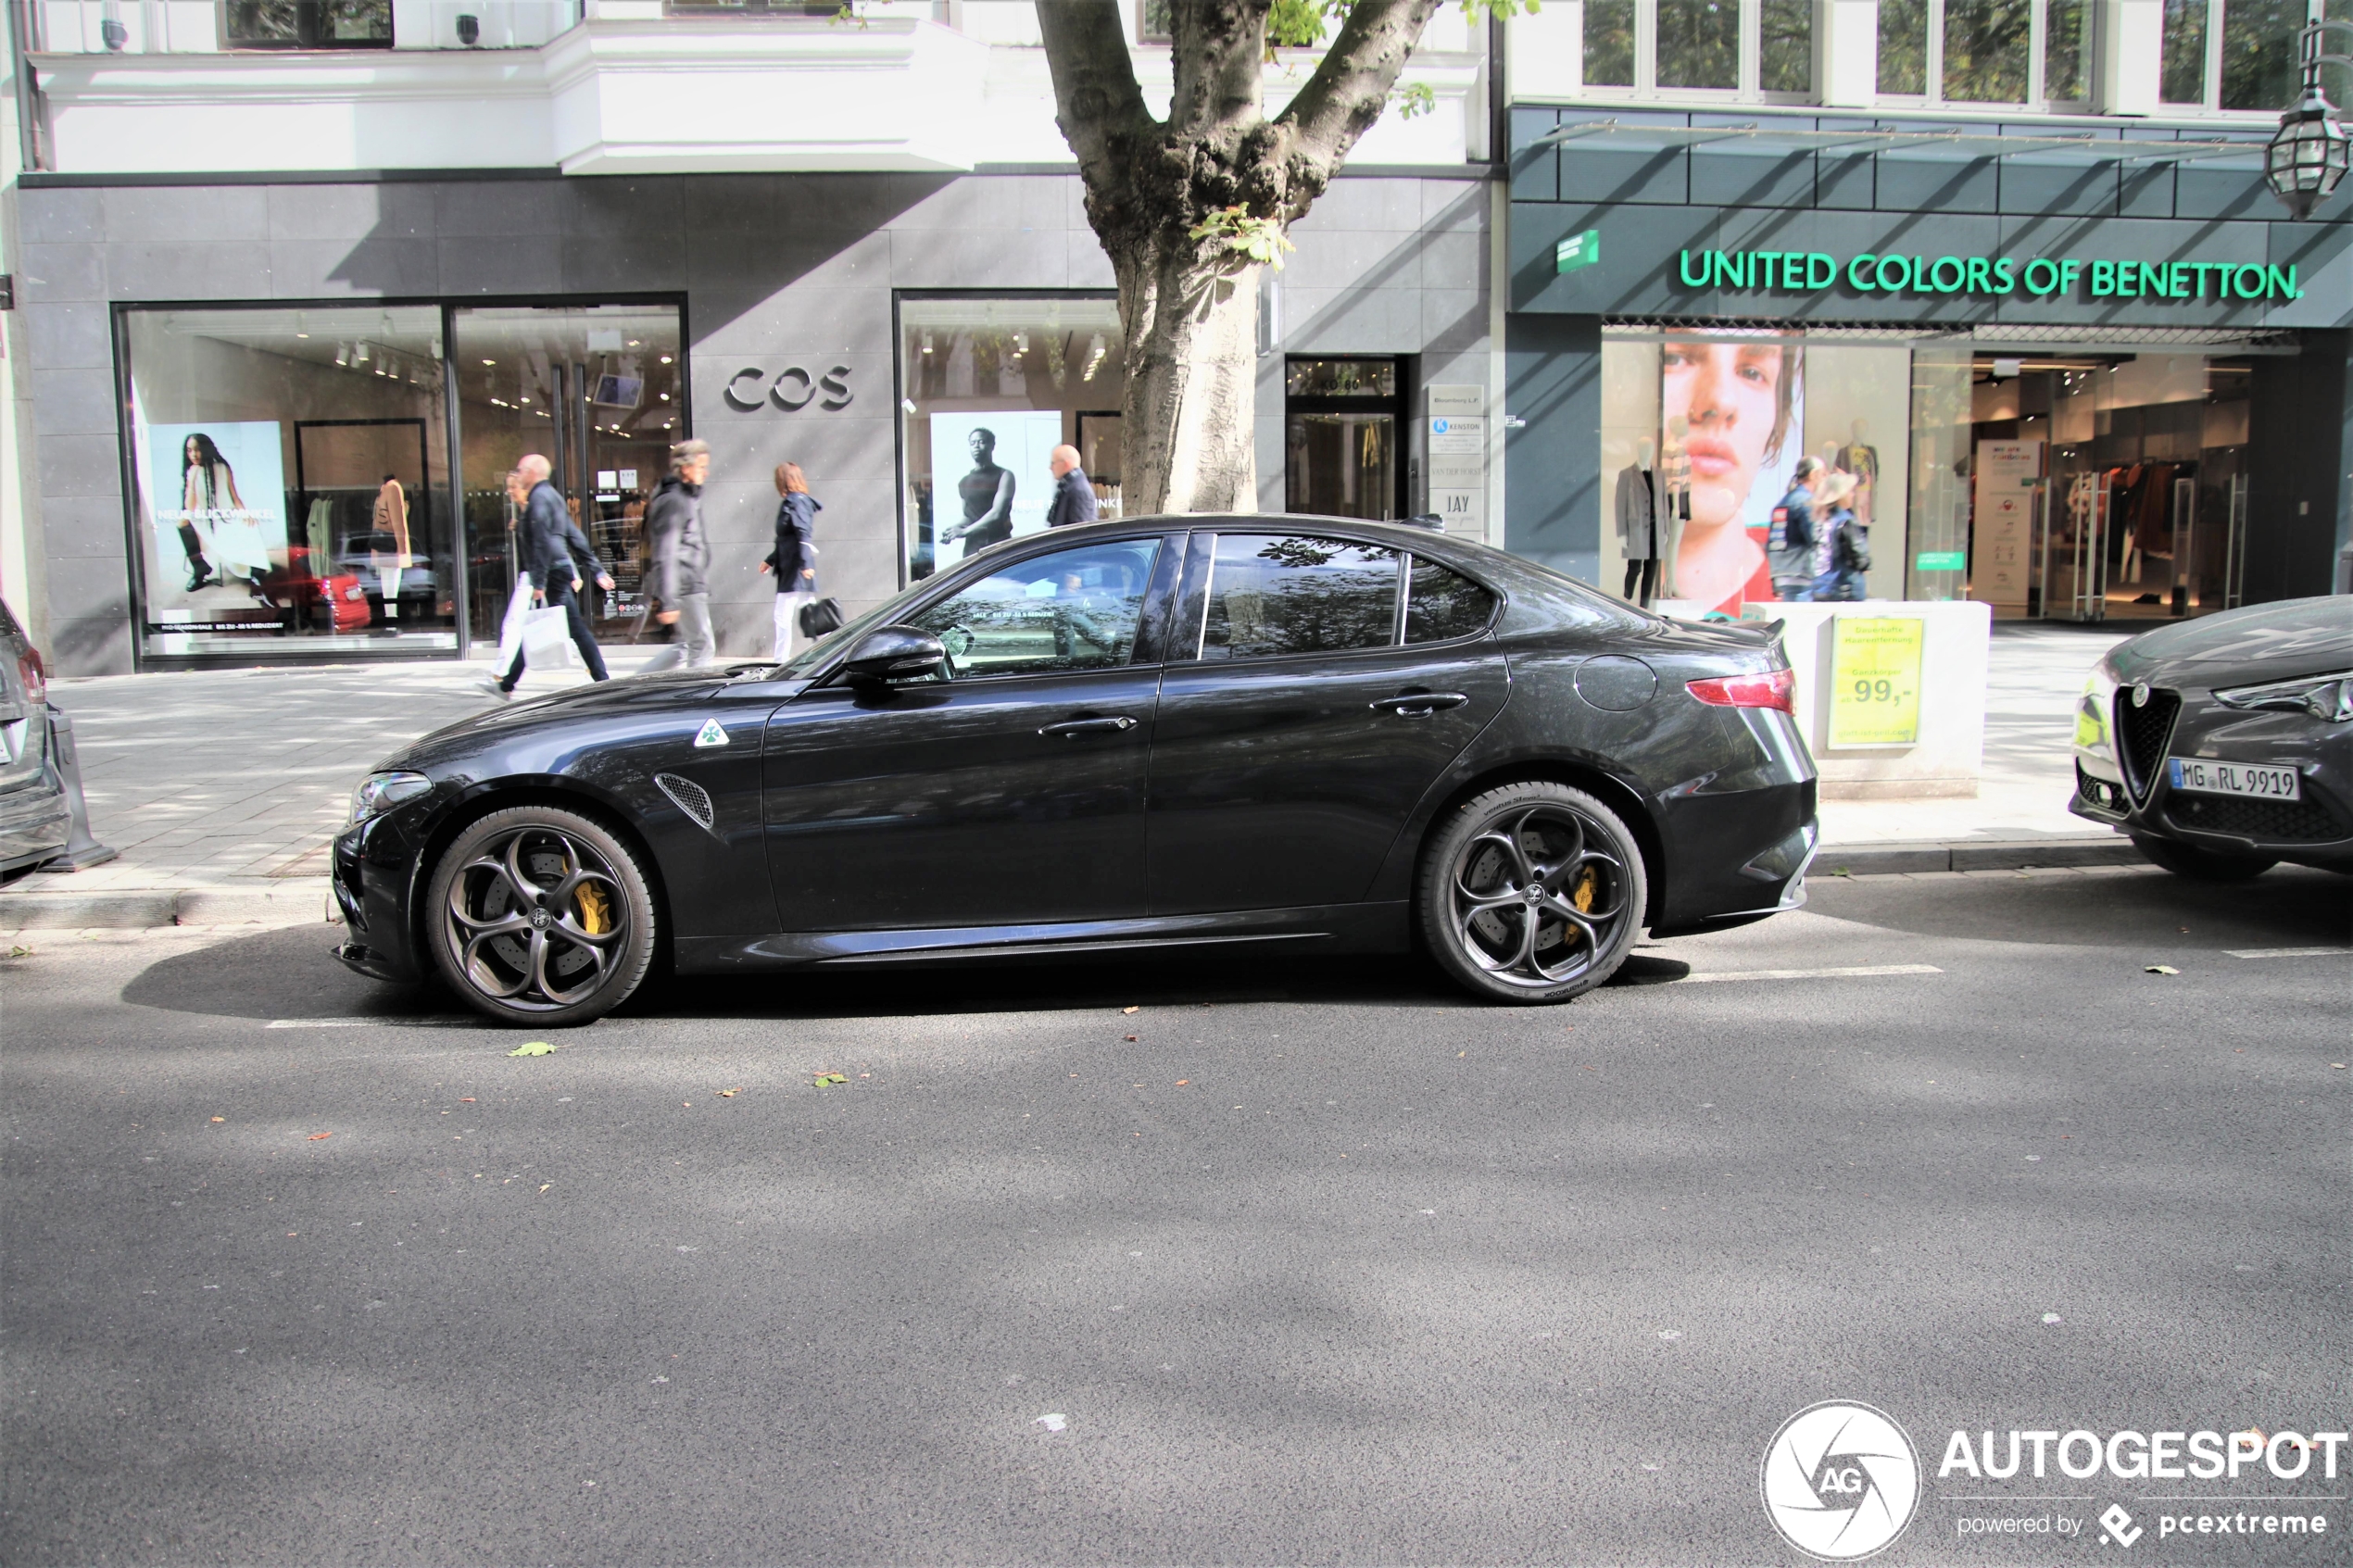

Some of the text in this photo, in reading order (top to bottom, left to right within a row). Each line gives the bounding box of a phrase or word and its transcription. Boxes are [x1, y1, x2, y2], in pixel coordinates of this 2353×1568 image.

[1680, 249, 2305, 300] UNITED COLORS OF BENETTON.
[723, 365, 854, 413] COS
[157, 508, 276, 520] NEUE BLICKWINKEL
[1854, 679, 1912, 708] 99,-
[2182, 763, 2206, 787] MG
[2218, 766, 2242, 791] RL
[2246, 770, 2295, 796] 9919
